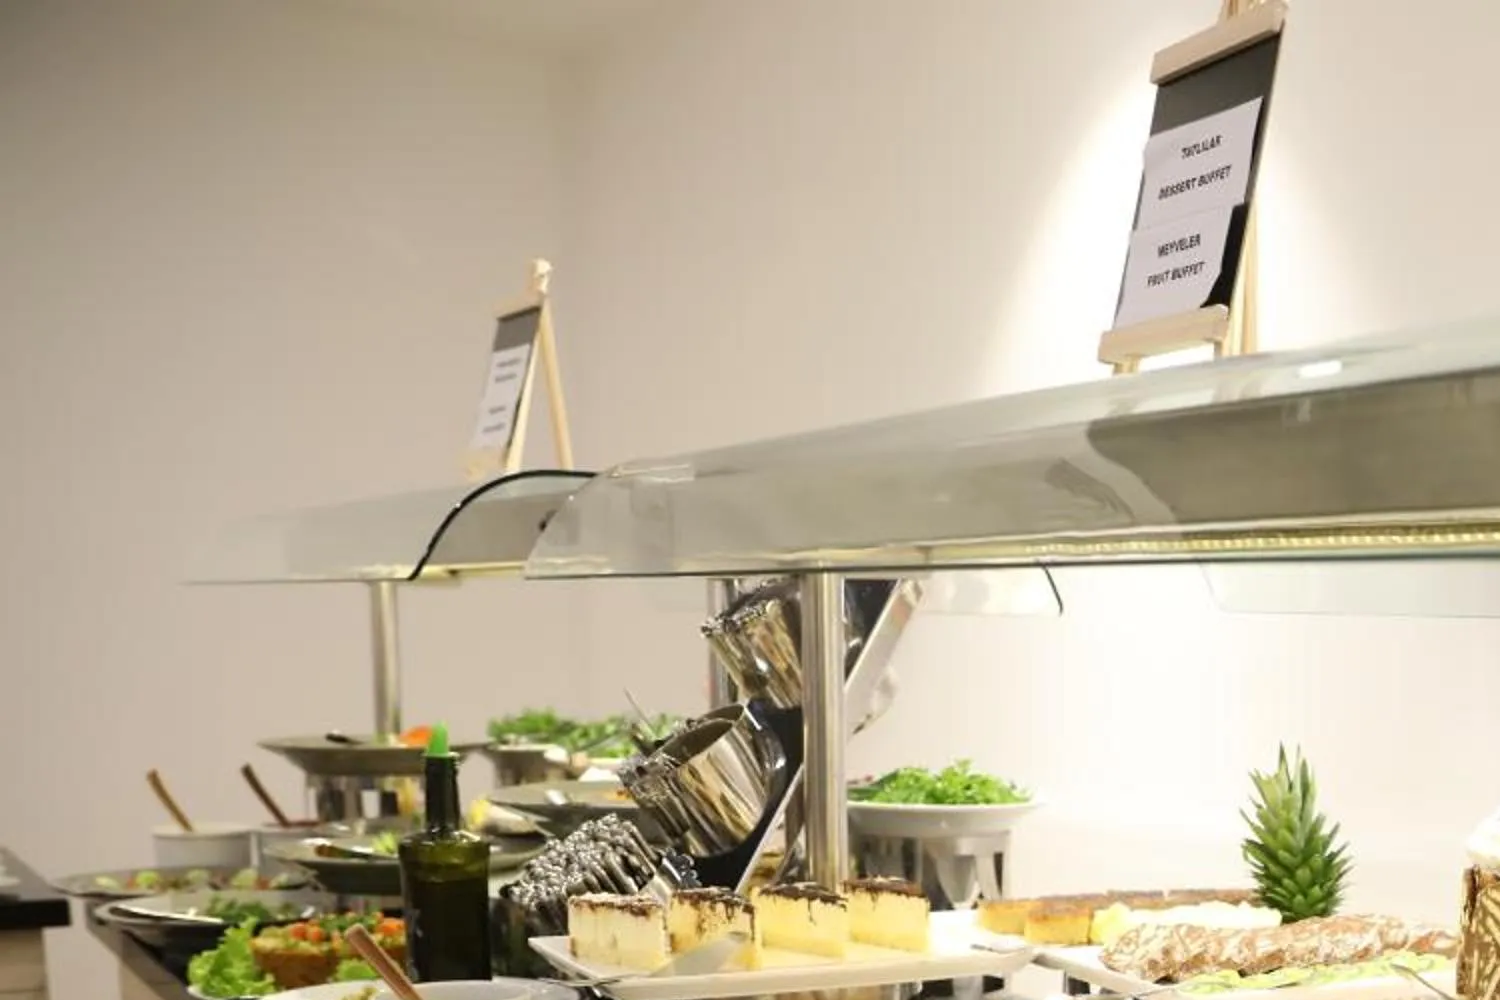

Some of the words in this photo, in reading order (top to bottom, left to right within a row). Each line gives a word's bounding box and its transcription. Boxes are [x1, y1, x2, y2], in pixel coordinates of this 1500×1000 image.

[1158, 177, 1197, 200] DESSERT
[1198, 165, 1232, 188] BUFFET
[1170, 261, 1207, 281] BUFFET
